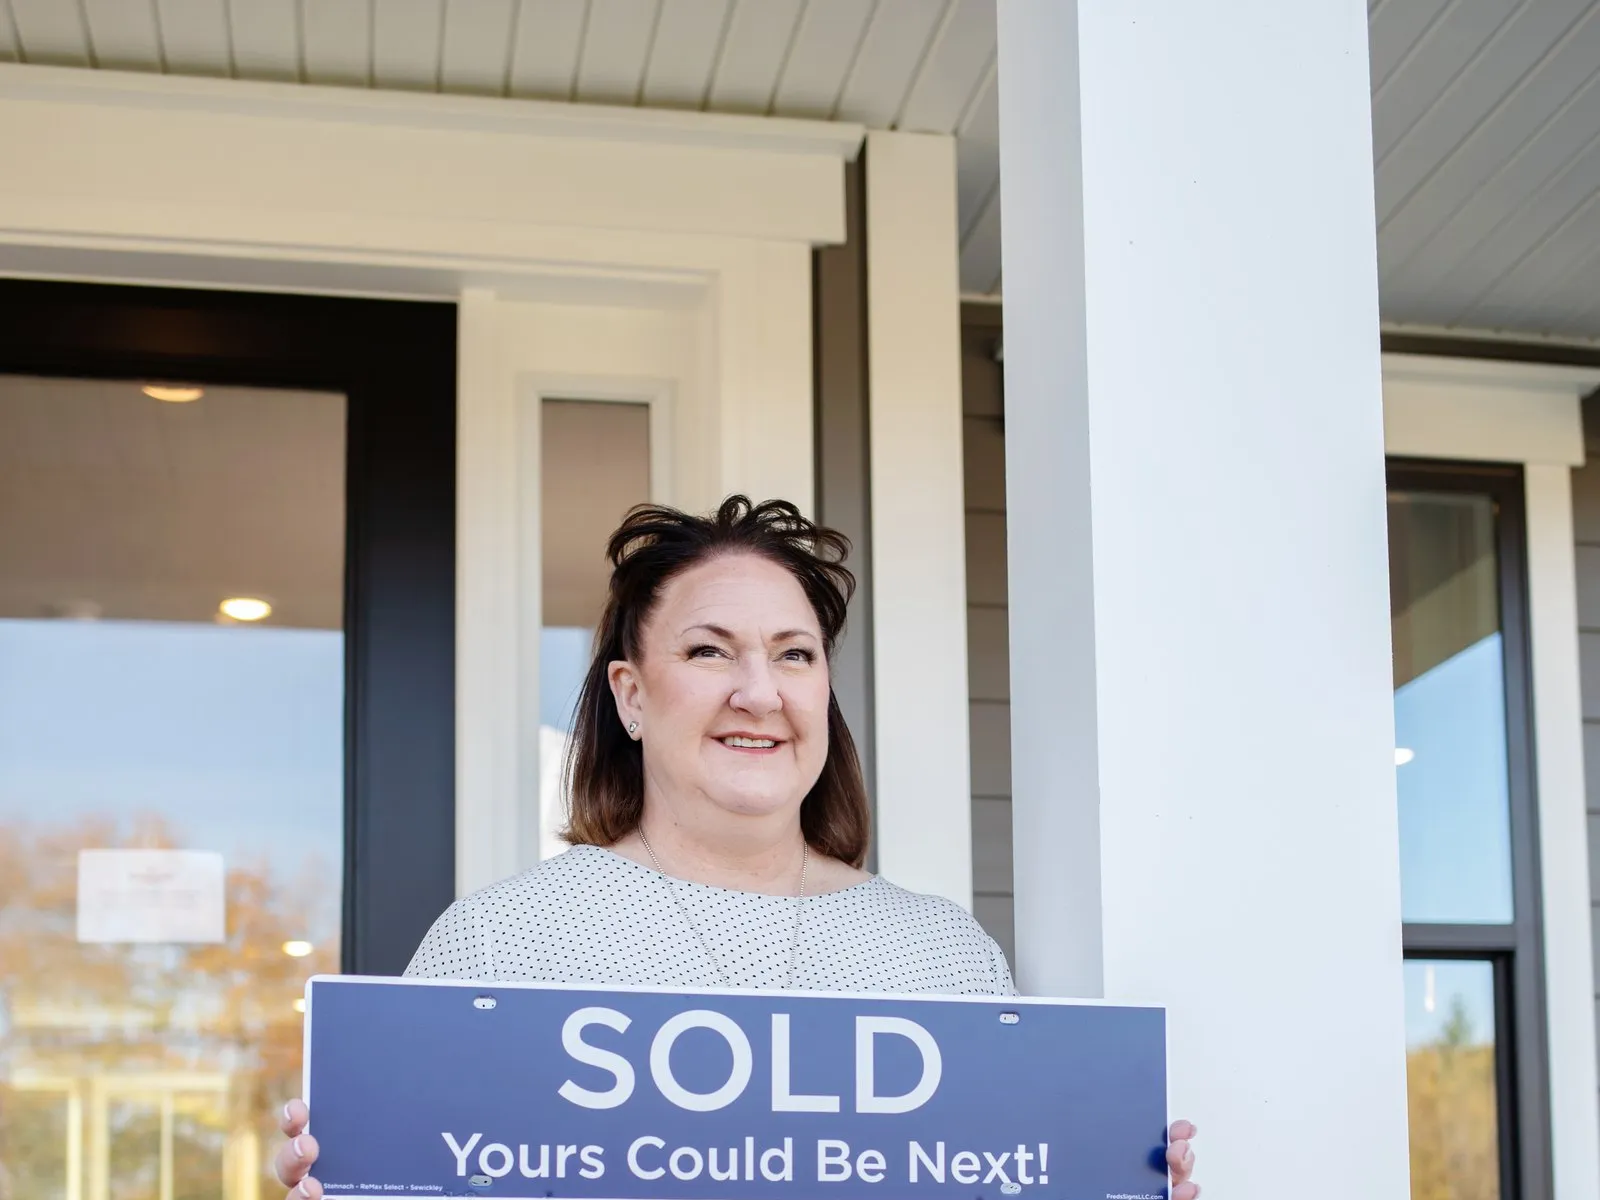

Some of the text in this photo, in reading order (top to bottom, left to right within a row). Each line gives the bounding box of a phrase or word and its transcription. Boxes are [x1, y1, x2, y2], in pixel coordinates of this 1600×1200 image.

[557, 1006, 943, 1114] SOLD
[441, 1132, 1049, 1185] Yours Could Be Next!
[384, 1183, 404, 1191] Select
[410, 1184, 443, 1192] Sewickley
